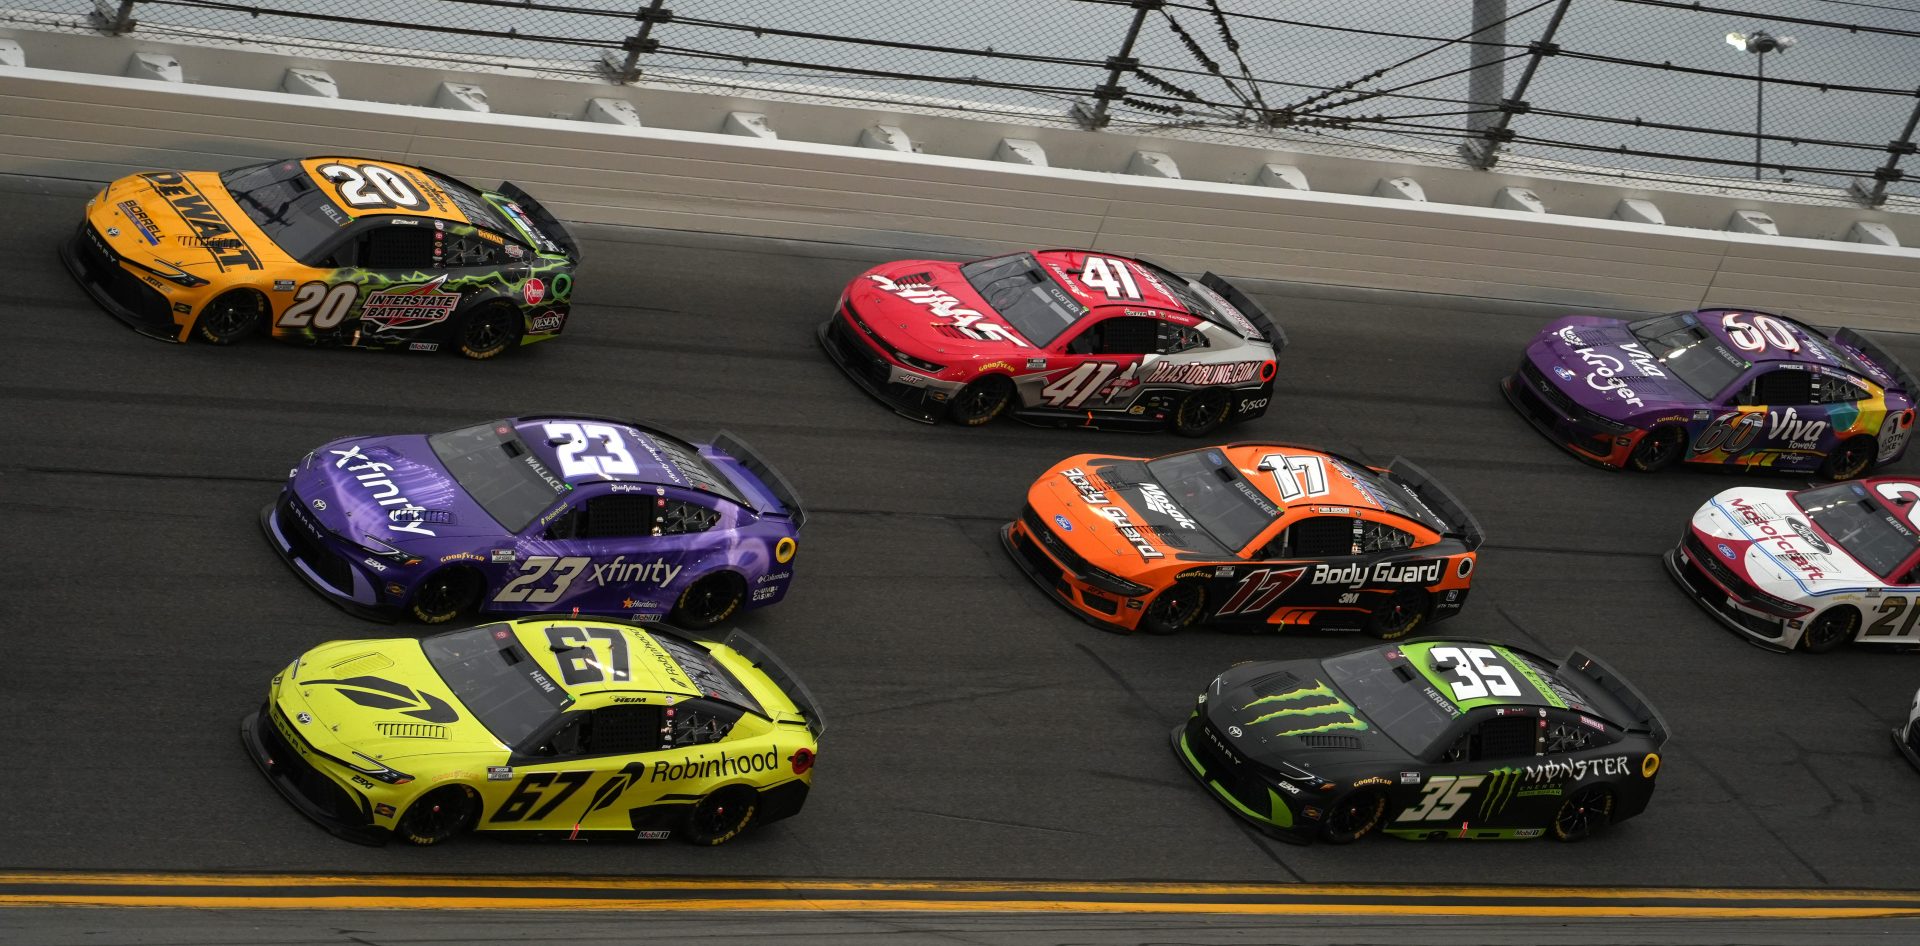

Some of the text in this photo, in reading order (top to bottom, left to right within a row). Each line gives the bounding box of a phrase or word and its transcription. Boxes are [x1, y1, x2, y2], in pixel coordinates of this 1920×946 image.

[318, 161, 422, 206] 20
[124, 199, 166, 243] BORRELL
[149, 171, 260, 271] DEWALT
[319, 203, 341, 224] BELL
[86, 228, 116, 264] CAMRY
[1081, 256, 1141, 300] 41
[277, 284, 358, 328] 20
[367, 307, 449, 320] BATTERIES
[368, 292, 453, 309] INTERSTATE
[1050, 288, 1080, 314] CUSTER
[1722, 313, 1799, 353] 60
[979, 361, 1015, 373] GOODYEAR
[1620, 343, 1666, 378] Viva
[1715, 346, 1742, 368] PREECE
[1042, 362, 1119, 409] 41
[1574, 347, 1644, 408] Kroger
[1693, 411, 1764, 453] 60
[1767, 407, 1827, 442] Viva
[544, 424, 640, 477] 23
[1788, 440, 1816, 450] Towels
[330, 445, 436, 537] xfinity
[525, 456, 563, 493] WALLACE
[1257, 453, 1330, 503] 17
[1060, 467, 1165, 559] Body Guard
[1139, 482, 1196, 530] Mosaic
[1234, 480, 1280, 517] BUESCHER
[290, 501, 323, 539] CAMRY
[1886, 516, 1912, 536] BERRY
[440, 552, 485, 562] GOODYEAR
[1727, 498, 1825, 581] Motorcraft
[364, 557, 387, 571] 23XI
[492, 555, 592, 603] 23
[587, 556, 683, 588] xfinity
[1176, 570, 1212, 579] GOODYEAR
[1311, 560, 1438, 589] Body Guard
[1215, 567, 1307, 616] 17
[1338, 593, 1360, 604] 3M
[545, 627, 630, 685] 67
[1430, 647, 1521, 700] 35
[530, 670, 555, 692] HEIM
[1424, 687, 1459, 717] HERBST
[273, 713, 307, 755] CAMRY
[1204, 727, 1241, 765] CAMRY
[351, 775, 374, 789] 23XI
[650, 745, 779, 783] Robinhood
[1353, 777, 1392, 787] GOODYEAR
[489, 771, 596, 823] 67
[1278, 780, 1300, 795] 23XI
[1396, 776, 1484, 822] 35
